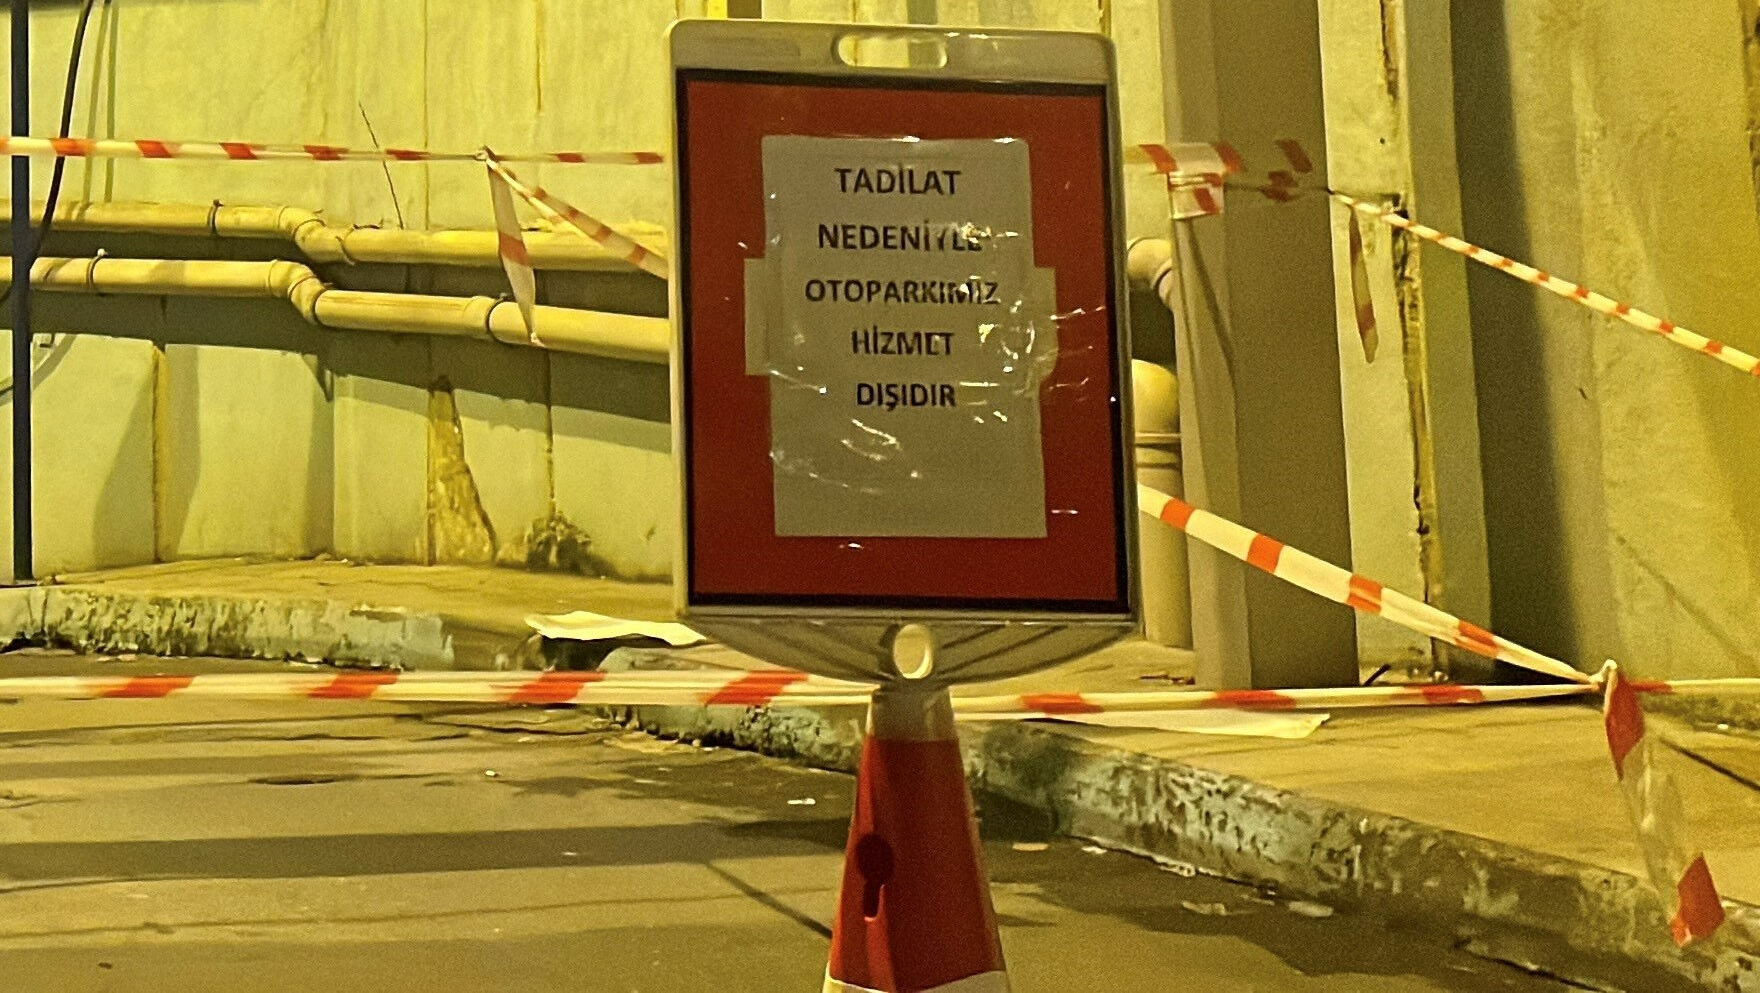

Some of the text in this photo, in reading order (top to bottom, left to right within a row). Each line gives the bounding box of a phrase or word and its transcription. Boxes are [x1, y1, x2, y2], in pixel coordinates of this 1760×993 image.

[834, 163, 962, 195] TADİLAT
[852, 325, 955, 356] HİZMET
[856, 382, 956, 412] DIŞIDIR
